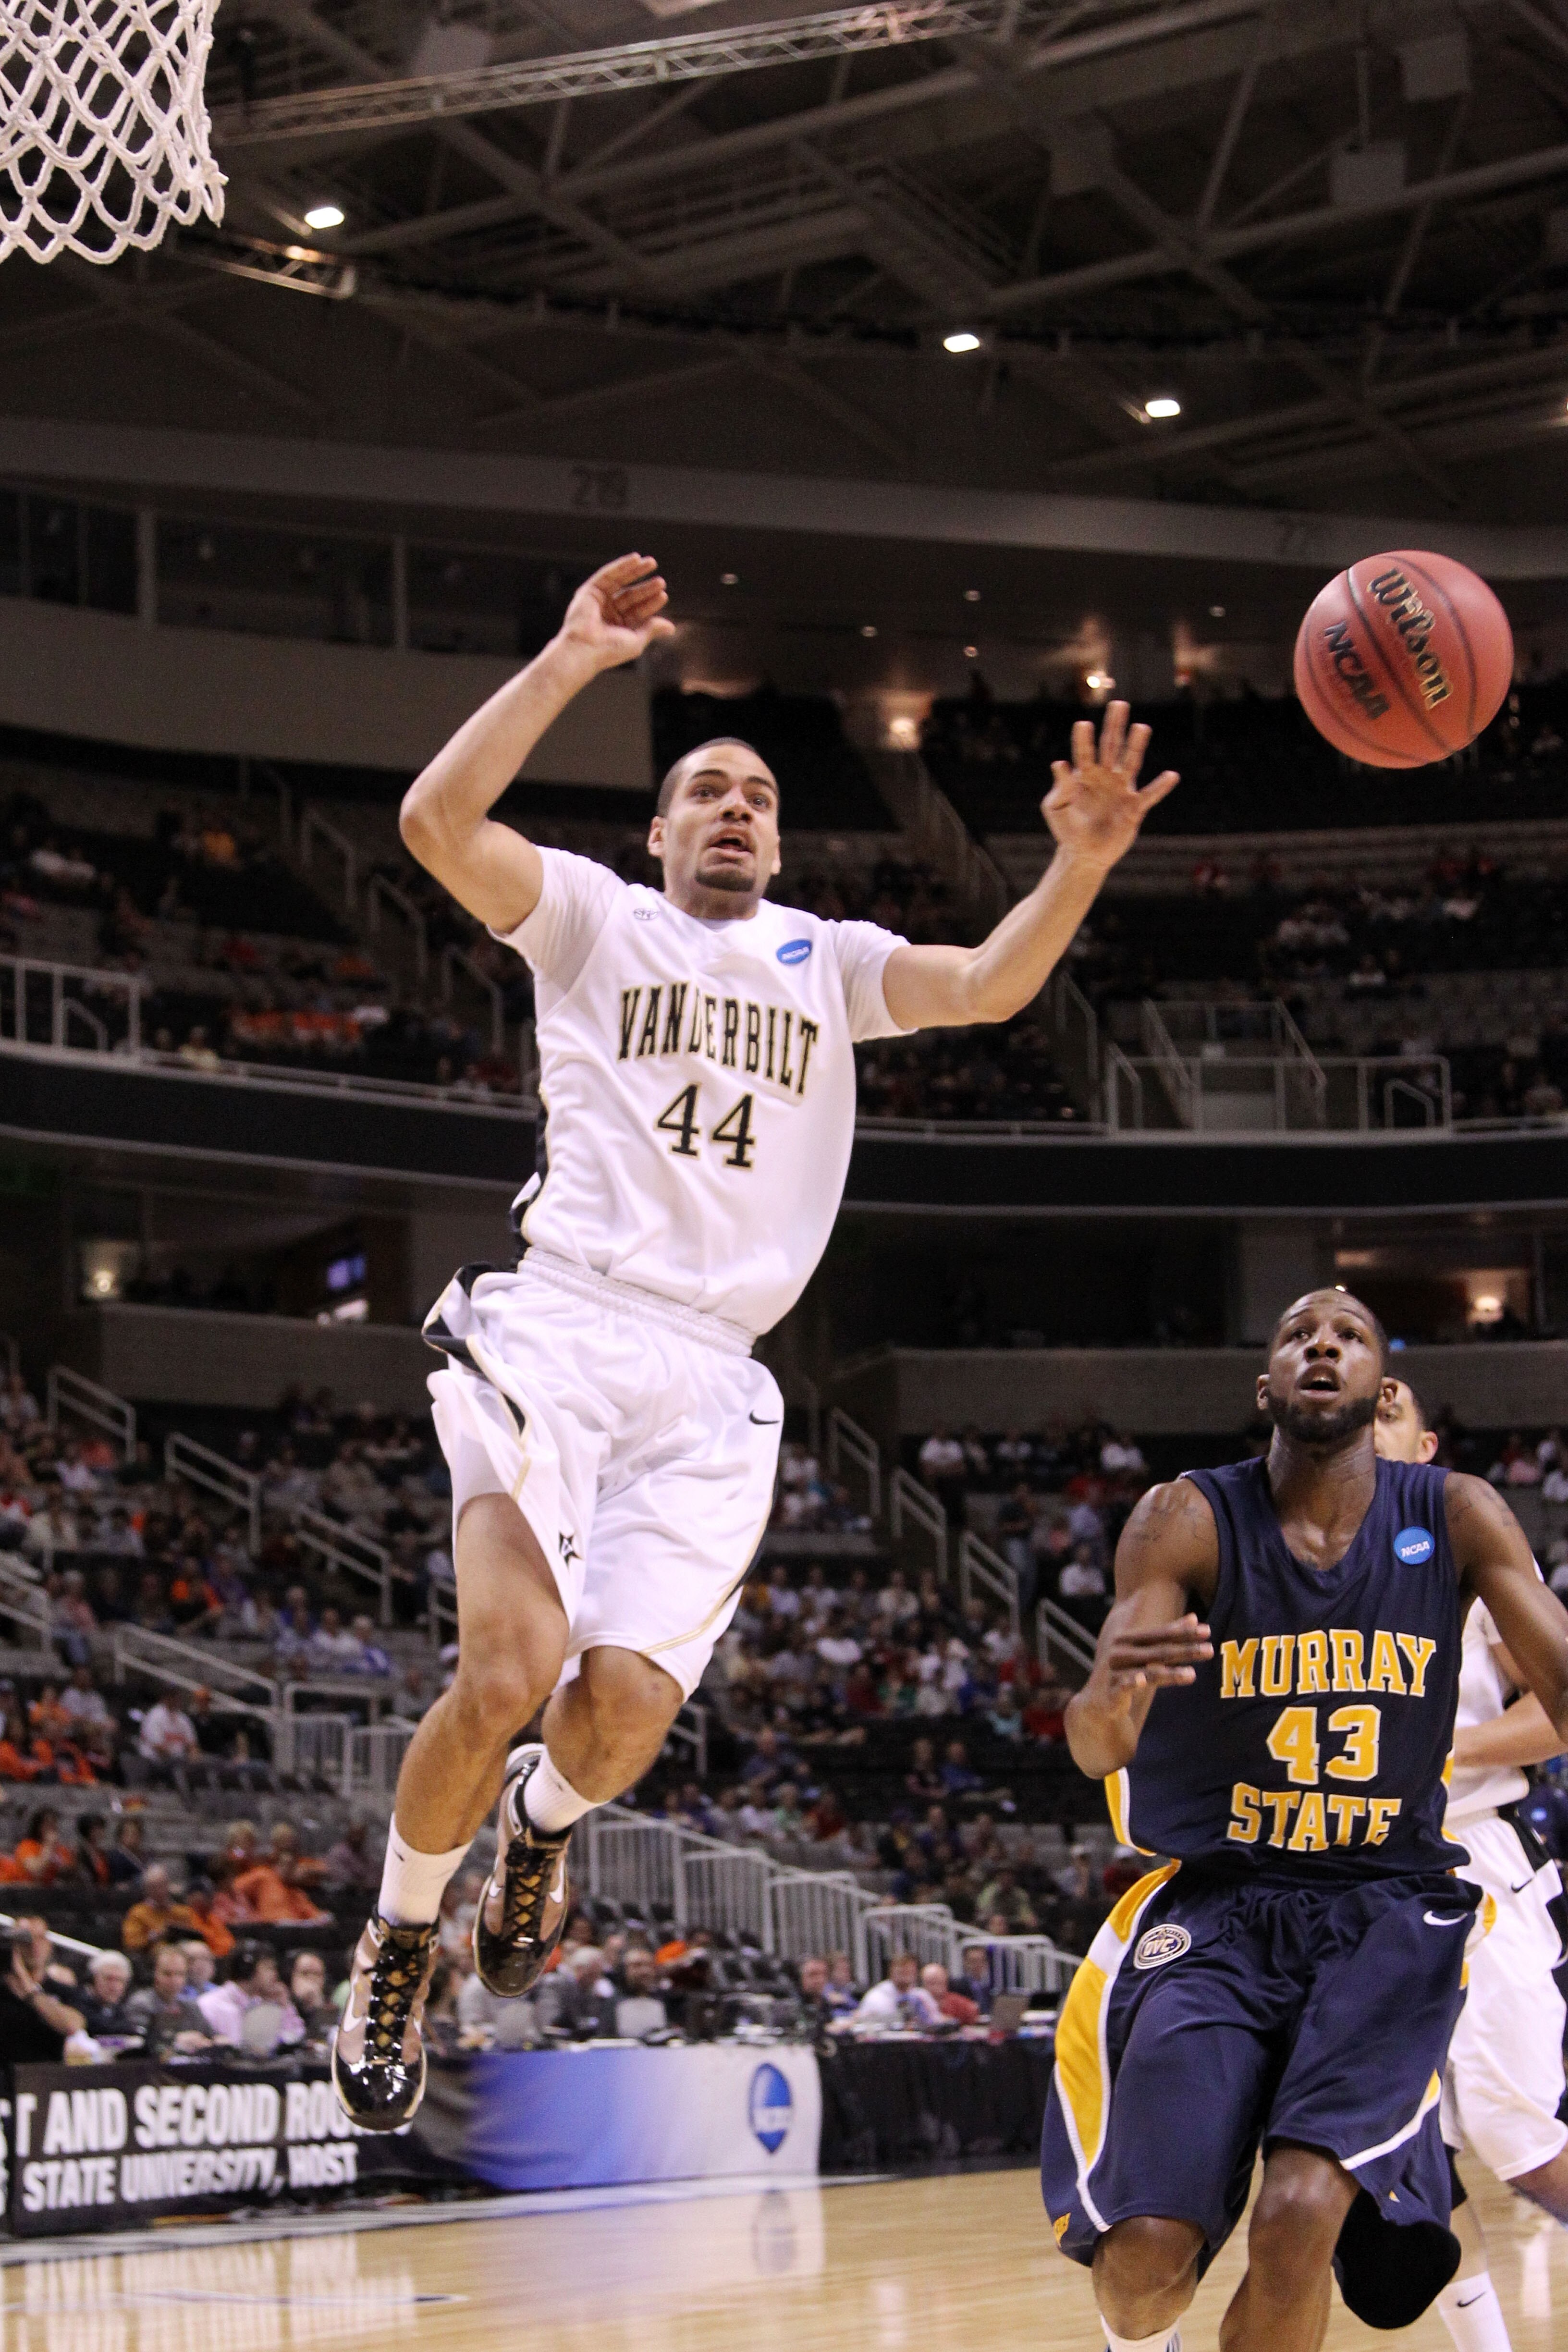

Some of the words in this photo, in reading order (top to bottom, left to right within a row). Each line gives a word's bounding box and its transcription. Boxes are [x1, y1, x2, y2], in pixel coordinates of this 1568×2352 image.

[1323, 620, 1390, 721] NCAA
[1367, 568, 1454, 711] Wilson
[616, 979, 820, 1097] VANDERBILT
[653, 1081, 755, 1172] 44
[1400, 1540, 1430, 1558] NCAA
[1220, 1628, 1437, 1699] MURRAY
[1266, 1703, 1382, 1786] 43
[1226, 1782, 1402, 1852] STATE
[42, 2087, 128, 2155] AND
[134, 2082, 281, 2148] SECOND
[22, 2156, 116, 2212] STATE
[288, 2141, 359, 2188] HOST
